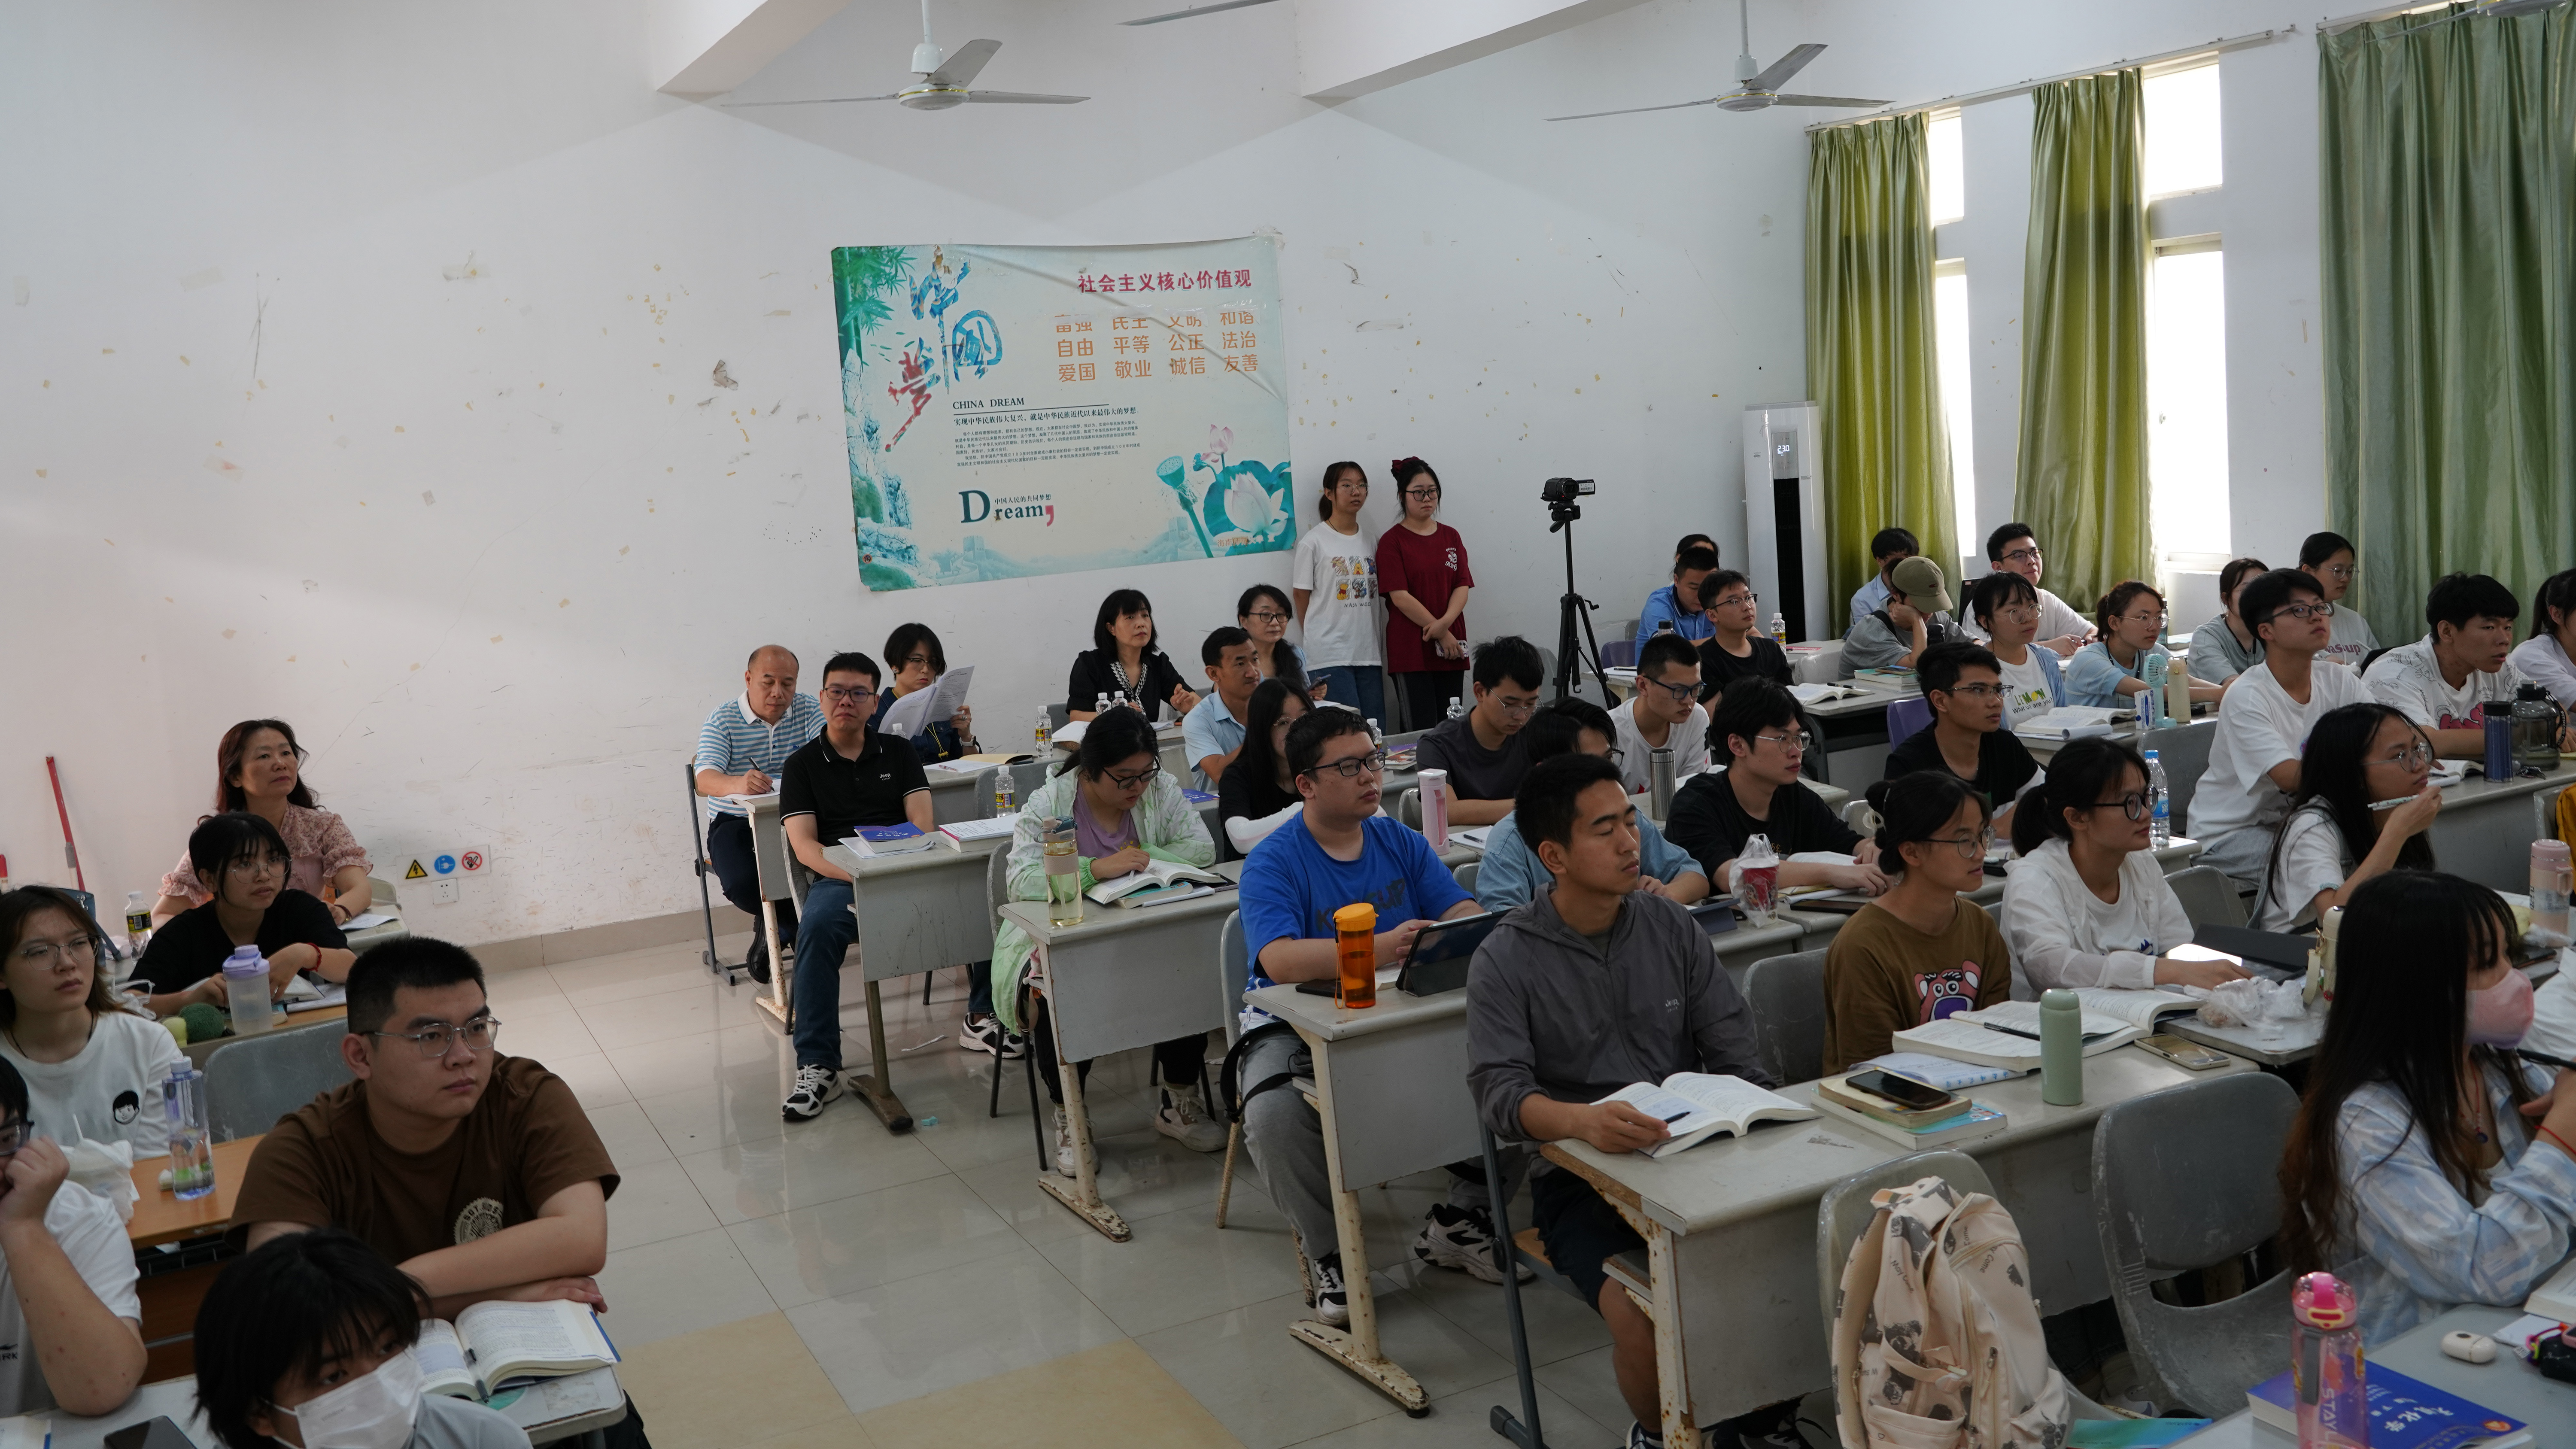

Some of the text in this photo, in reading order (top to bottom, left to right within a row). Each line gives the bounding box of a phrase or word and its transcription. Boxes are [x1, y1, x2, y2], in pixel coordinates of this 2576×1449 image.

[1078, 269, 1252, 294] 社会主义核心价值观
[1057, 331, 1256, 357] 自由 平等 公正 法治
[1059, 354, 1258, 382] 爱国 敬业 诚信 友善
[953, 398, 1024, 409] CHINA DREAM
[994, 494, 1051, 505] 中国人民的共同梦想
